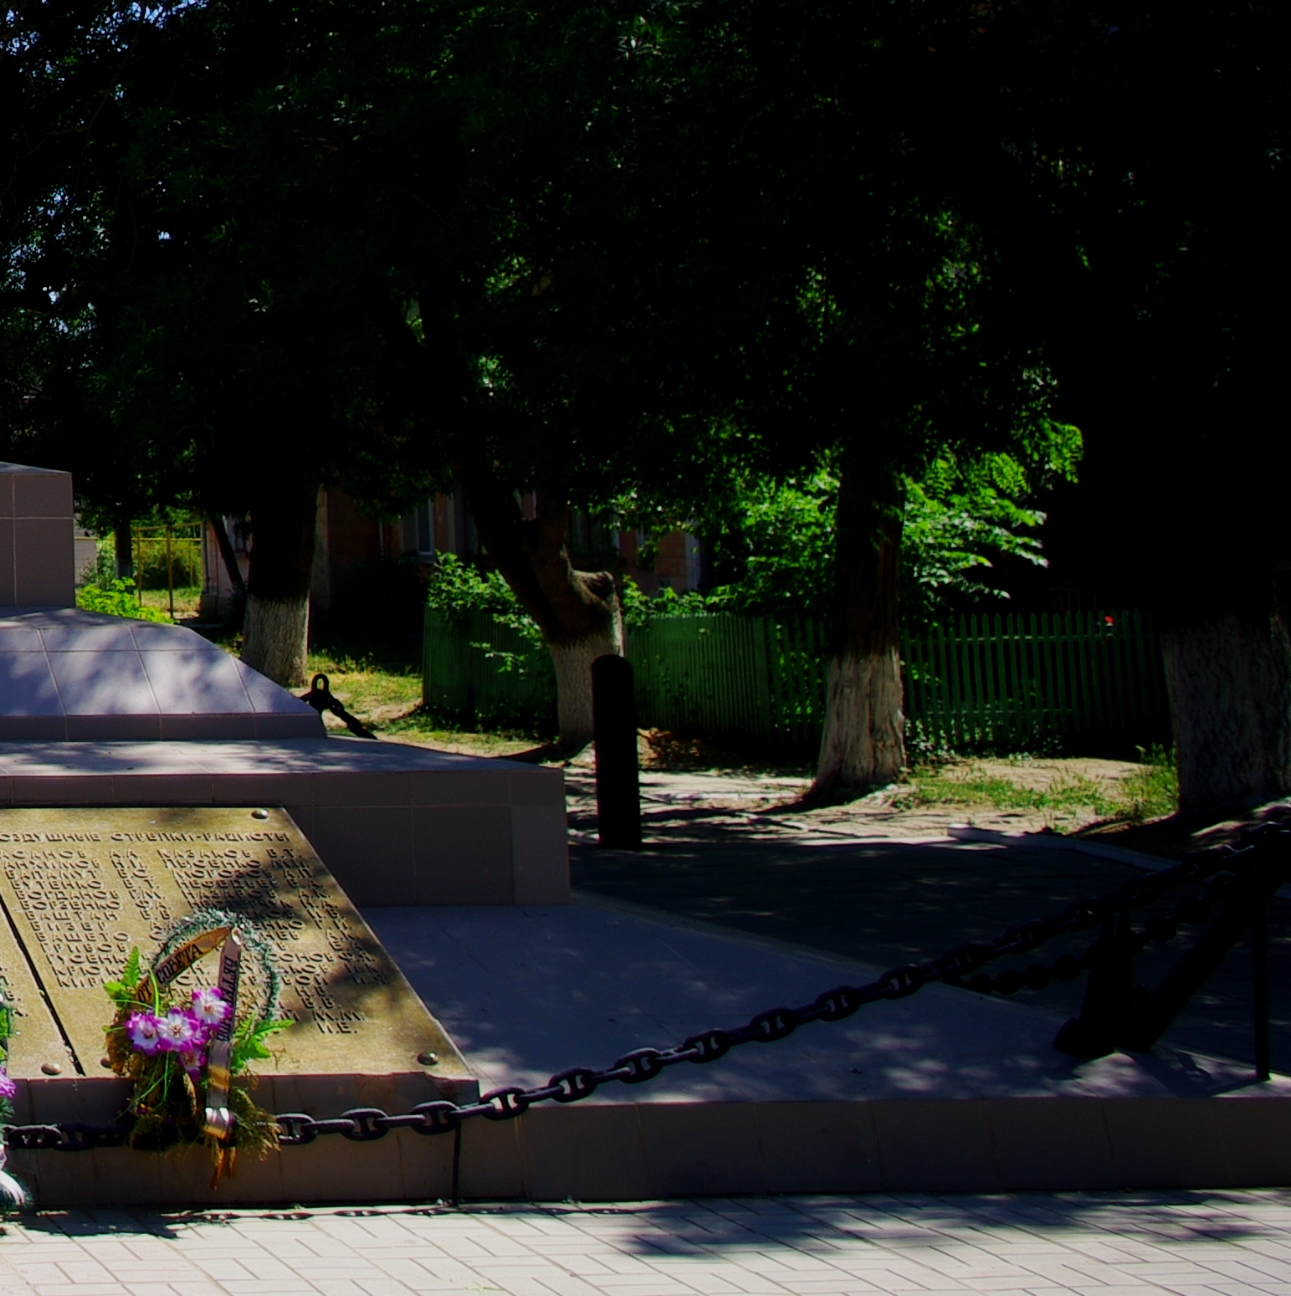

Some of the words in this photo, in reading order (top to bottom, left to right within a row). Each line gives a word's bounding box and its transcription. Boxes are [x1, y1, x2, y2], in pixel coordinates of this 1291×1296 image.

[110, 832, 290, 842] СТРЕЛКИ-РАДИСТЫ
[157, 849, 252, 858] КАЗАКОВ
[3, 860, 101, 870] АНХИМОВ
[172, 869, 274, 879] МОРОЗОВ
[15, 890, 119, 900] БОГДАНОВ
